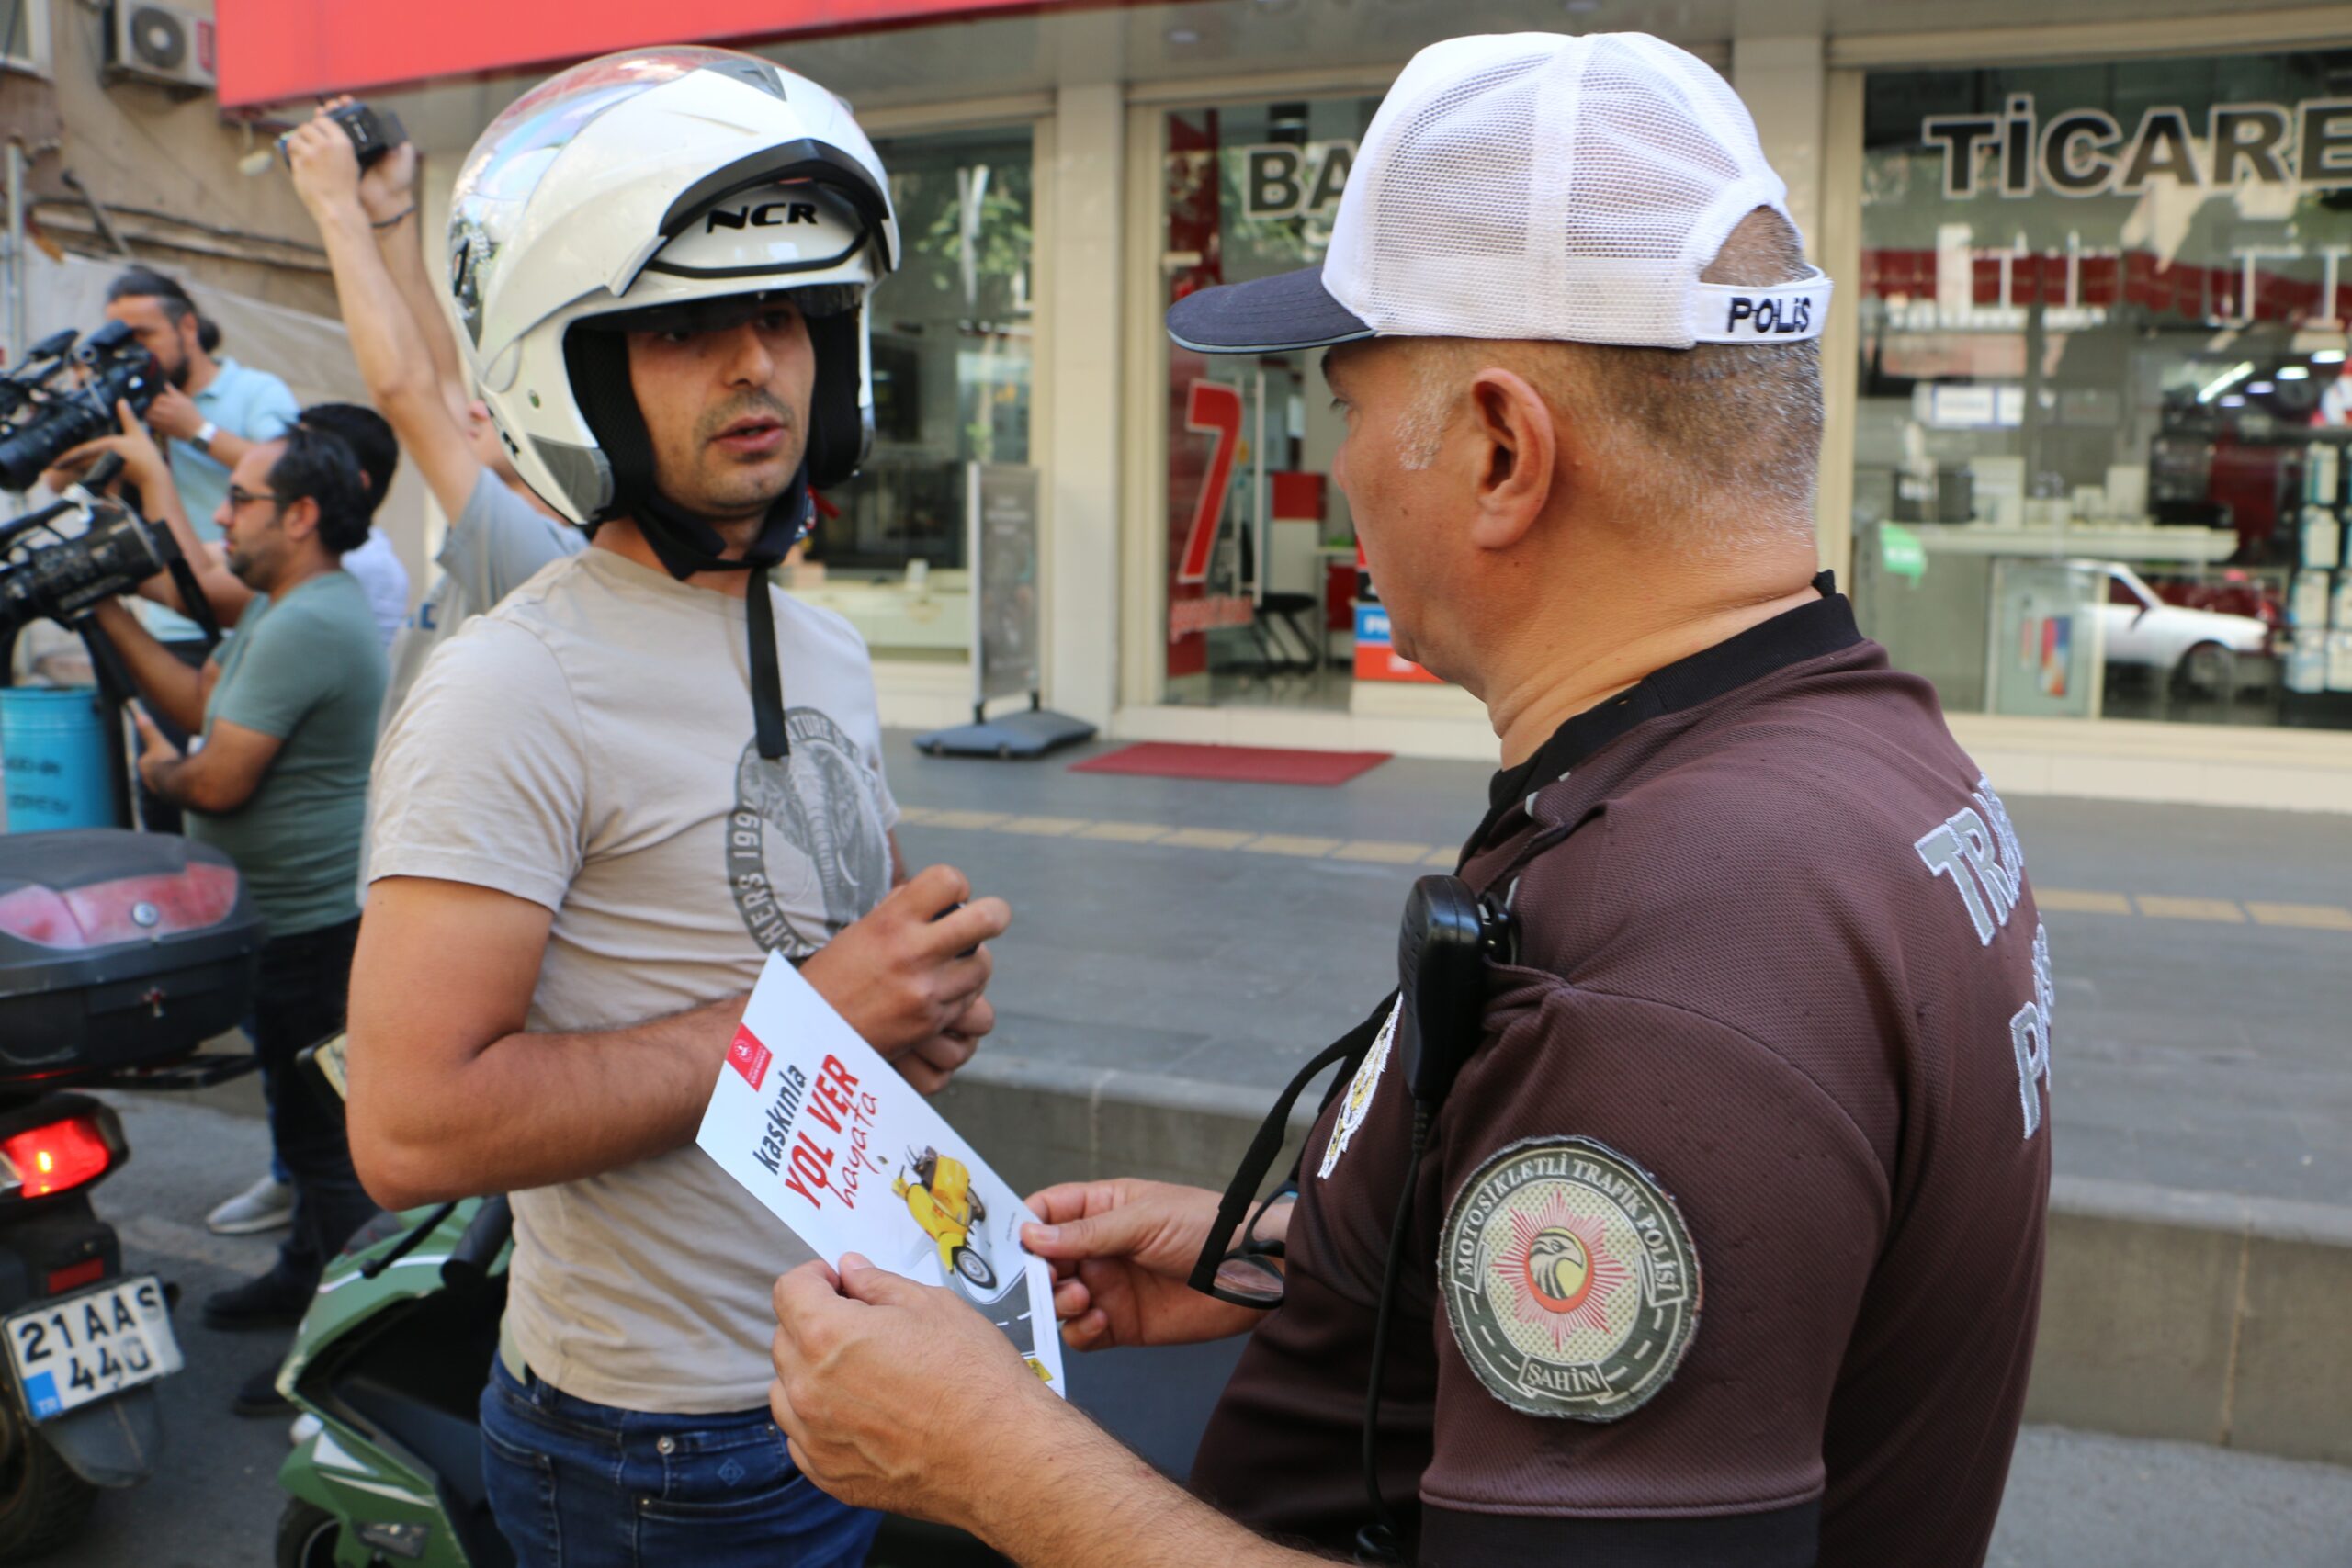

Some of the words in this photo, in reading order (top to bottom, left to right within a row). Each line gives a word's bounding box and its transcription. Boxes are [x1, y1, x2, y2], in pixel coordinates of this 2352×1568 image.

[706, 202, 818, 234] NCR
[1727, 296, 1811, 333] POLİS
[752, 1064, 808, 1176] kaskınla
[806, 1054, 860, 1135] VER
[785, 1130, 835, 1211] YOL
[826, 1091, 881, 1210] hayata
[1458, 1153, 1567, 1277] MOTOSİKLETLİ
[1573, 1158, 1647, 1219] TRAFİK
[1637, 1213, 1681, 1291] POLİSİ
[19, 1313, 74, 1364] 21
[1527, 1363, 1599, 1393] ŞAHİN
